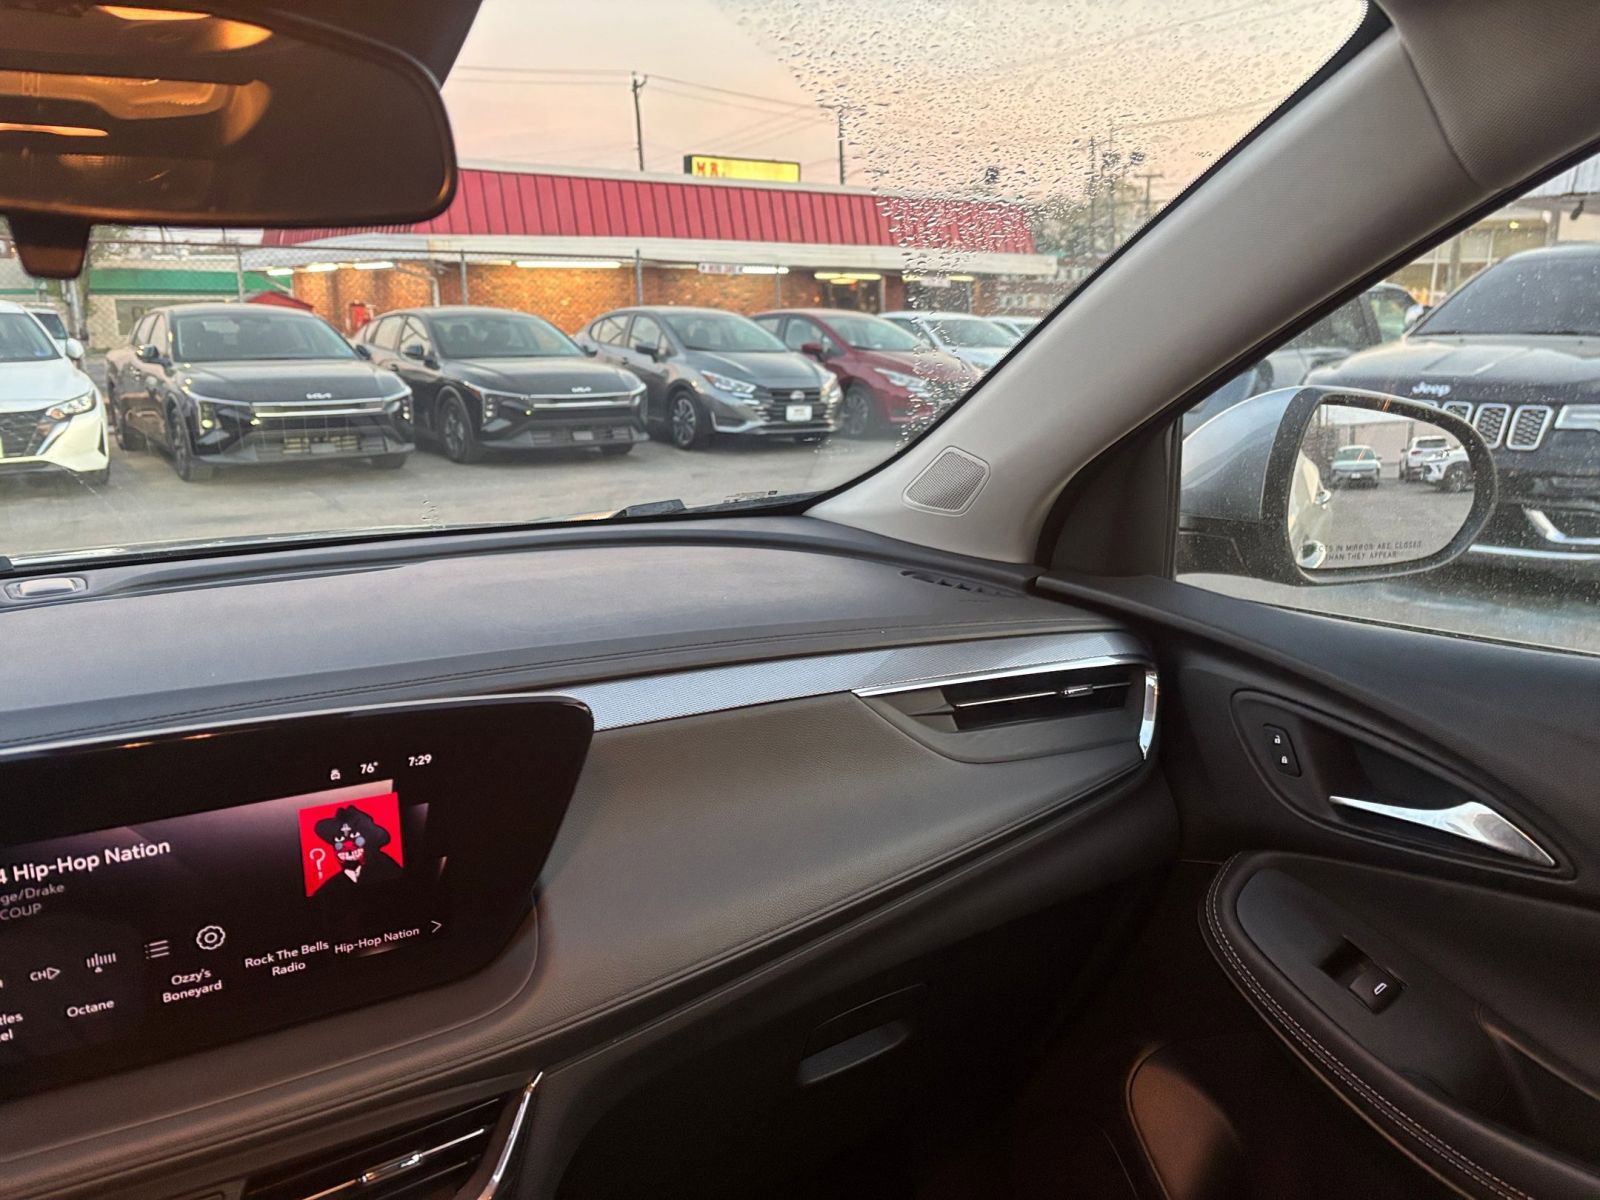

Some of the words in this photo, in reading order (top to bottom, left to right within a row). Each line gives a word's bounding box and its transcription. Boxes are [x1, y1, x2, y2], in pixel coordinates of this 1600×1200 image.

[1412, 381, 1451, 397] Jeep
[1345, 543, 1374, 552] MIRROR
[1377, 541, 1392, 550] ARE
[1394, 540, 1423, 550] CLOSER
[1347, 552, 1366, 560] THEY
[1369, 550, 1397, 560] APPEAR
[408, 754, 432, 767] 7:29
[13, 855, 100, 882] Hip-Hop
[104, 841, 171, 865] Nation
[0, 902, 42, 920] COUP
[334, 935, 382, 954] Hip-Hop
[384, 927, 420, 943] Nation
[244, 954, 275, 968] Rock
[275, 949, 299, 961] The
[301, 940, 329, 955] Bells
[171, 968, 212, 986] Ozzy's
[271, 961, 306, 977] Radio
[162, 980, 223, 1003] Boneyard
[66, 1000, 115, 1018] Octane
